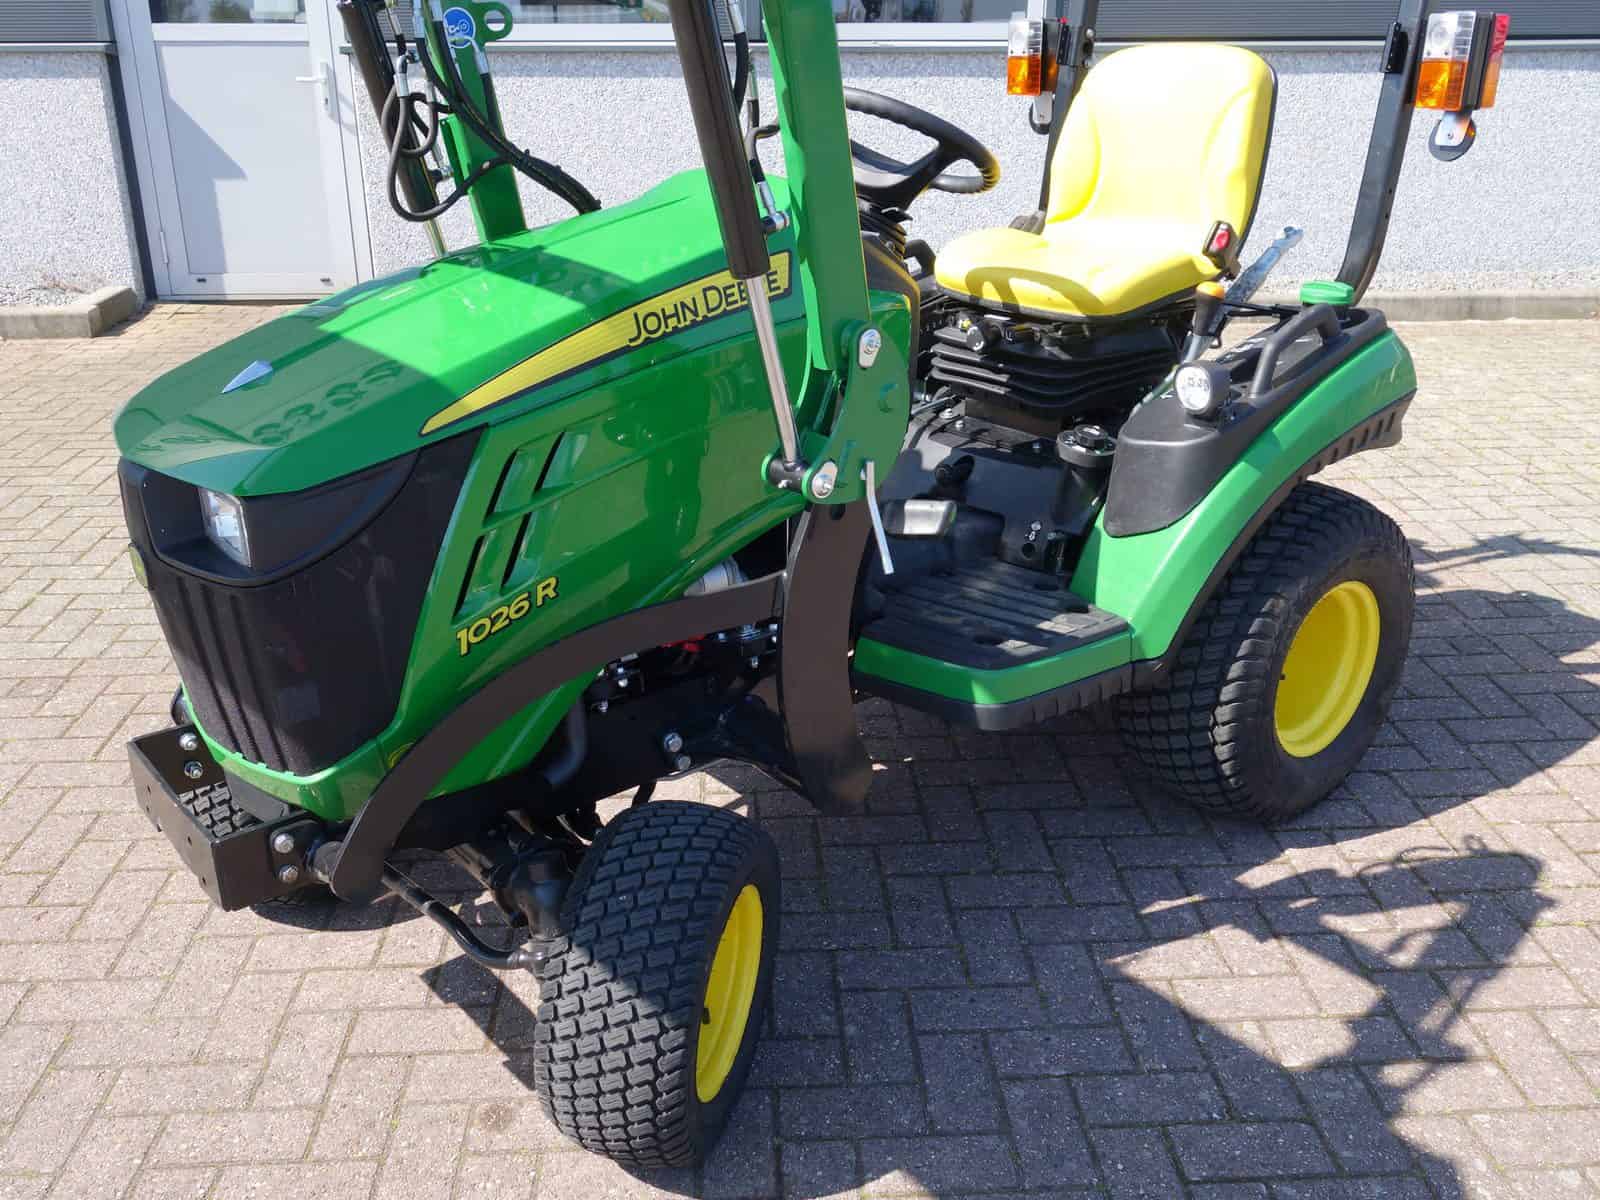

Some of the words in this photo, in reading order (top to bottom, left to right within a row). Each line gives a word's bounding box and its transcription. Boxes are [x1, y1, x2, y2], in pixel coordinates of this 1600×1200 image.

[628, 296, 698, 344] JOHN
[702, 270, 781, 314] DEEE
[456, 592, 530, 656] 1026
[536, 576, 558, 606] R
